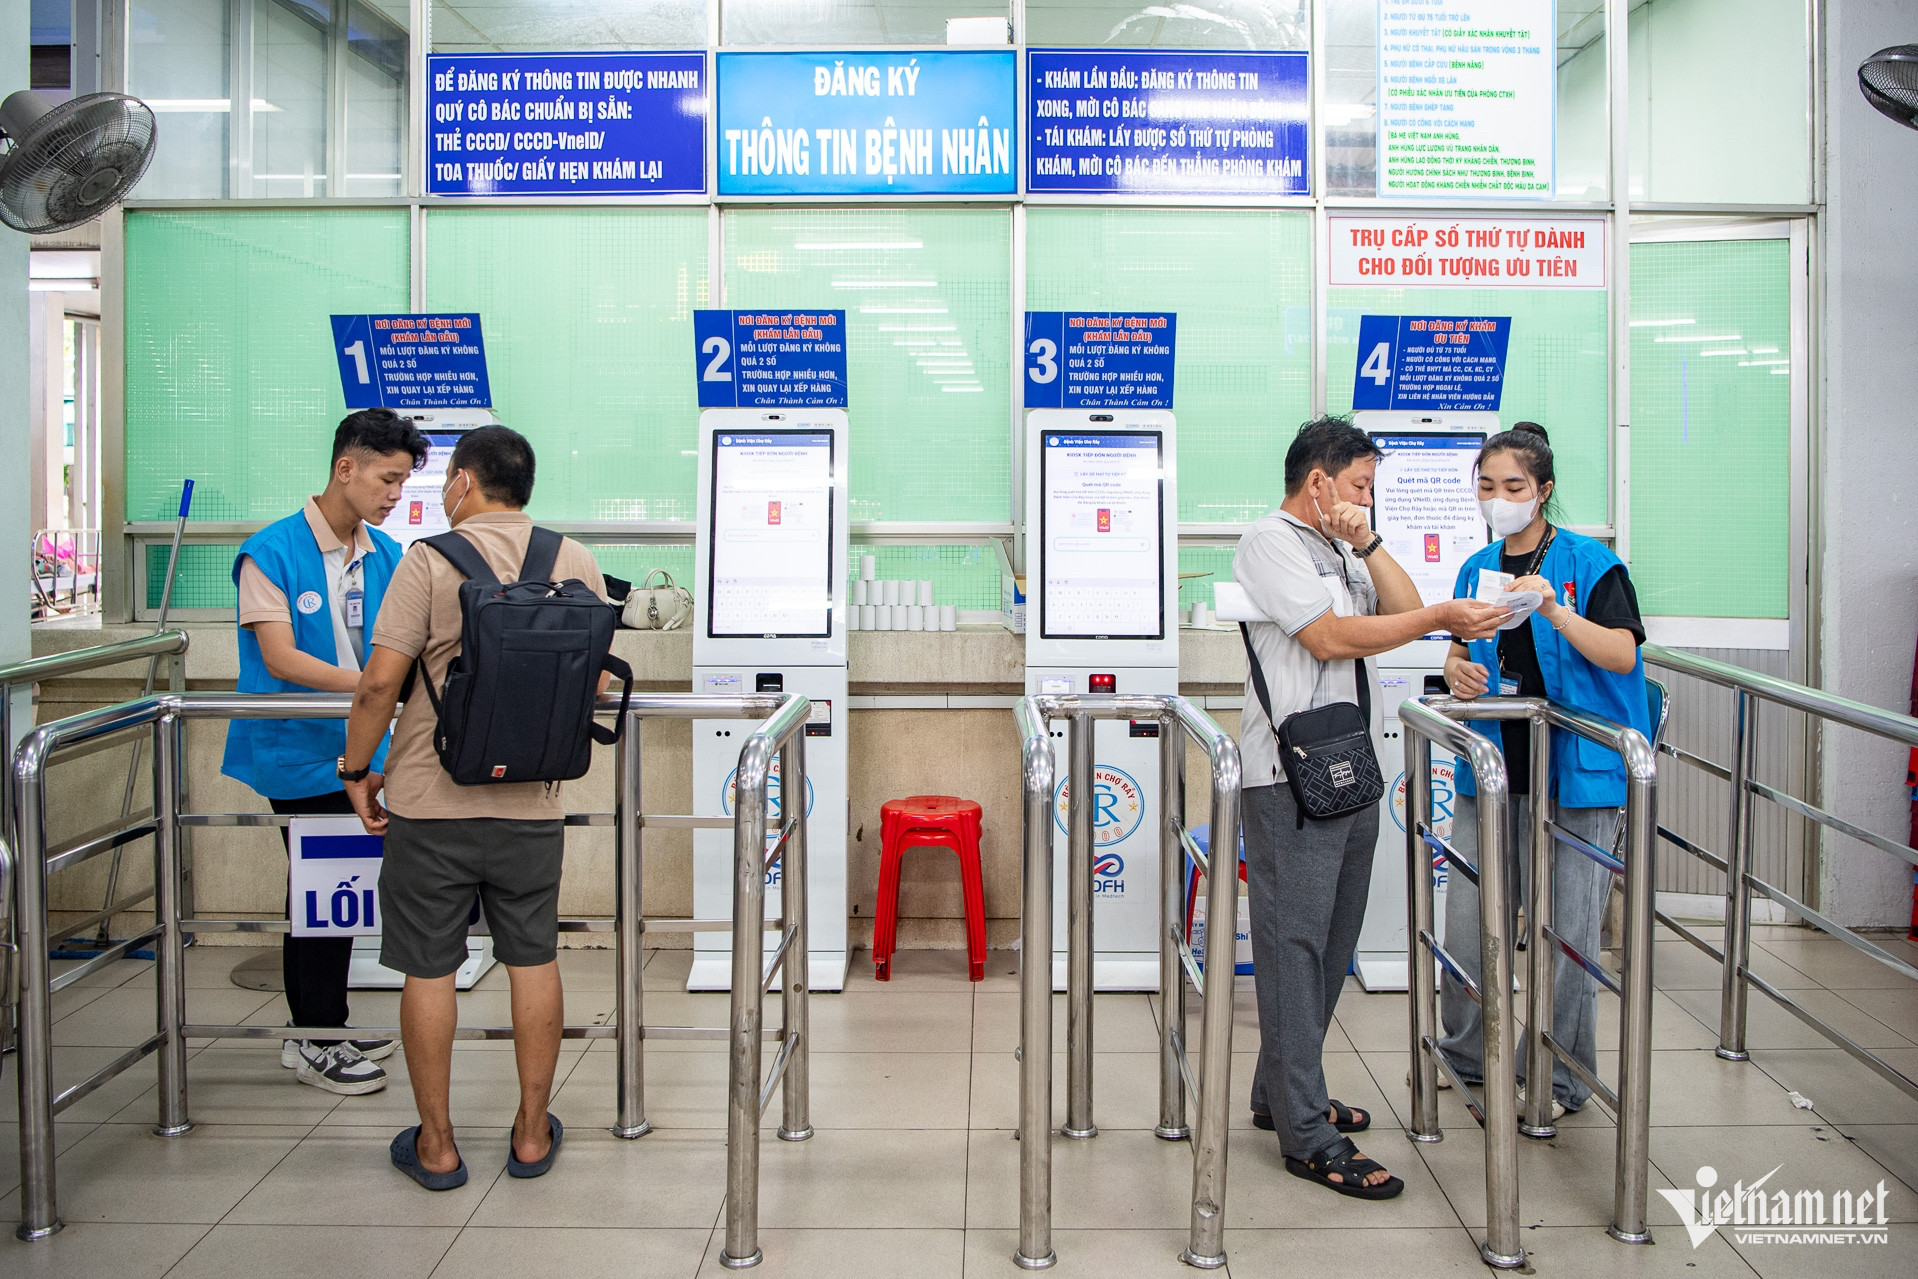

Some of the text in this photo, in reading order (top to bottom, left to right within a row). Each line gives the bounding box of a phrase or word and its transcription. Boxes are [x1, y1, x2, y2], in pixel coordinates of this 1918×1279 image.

[435, 67, 698, 93] ĐỂ ĐĂNG KÝ THÔNG TIN ĐƯỢC NHANH
[814, 58, 920, 96] ĐĂNG KÝ
[1045, 66, 1258, 90] KHÁM LẦN ĐẦU: ĐĂNG KÝ THÔNG TIN
[436, 100, 464, 123] QUÝ
[468, 100, 487, 121] CÔ
[491, 100, 520, 120] BÁC
[525, 95, 574, 120] CHUẨN
[579, 102, 593, 123] BỊ
[1037, 100, 1072, 120] XONG,
[1076, 96, 1100, 117] MỜI
[1103, 97, 1118, 117] CÔ
[1122, 98, 1147, 118] BÁC
[435, 128, 462, 151] THẺ
[466, 133, 510, 151] CCCD/
[726, 116, 1009, 184] THÔNG TIN BỆNH NHÂN
[1045, 124, 1274, 151] TÁI KHÁM: LẤY ĐƯỢC SỐ THỨ TỰ PHÒNG
[435, 156, 662, 183] TOA THUỐC/ GIẤY HẸN KHÁM LẠI
[1037, 152, 1301, 177] KHÁM, MỜI CÔ BÁC ĐẾN THẲNG PHÒNG KHÁM
[1350, 223, 1584, 251] TRỤ CẤP SỐ THỨ TỰ DÀNH
[1359, 252, 1577, 280] CHO ĐỐI TƯỢNG ƯU TIÊN
[702, 337, 732, 381] 2
[741, 357, 757, 366] QUÁ
[766, 355, 776, 365] SỐ
[758, 344, 777, 353] LƯỢT
[780, 343, 800, 352] ĐĂNG
[803, 343, 813, 352] KÝ
[815, 342, 840, 352] KHÔNG
[1029, 338, 1057, 384] 3
[344, 340, 370, 384] 1
[1360, 342, 1390, 385] 4
[743, 383, 831, 394] XIN QUAY LẠI XẾP HÀNG
[1105, 774, 1122, 785] CHỢ
[306, 876, 374, 928] LỐI
